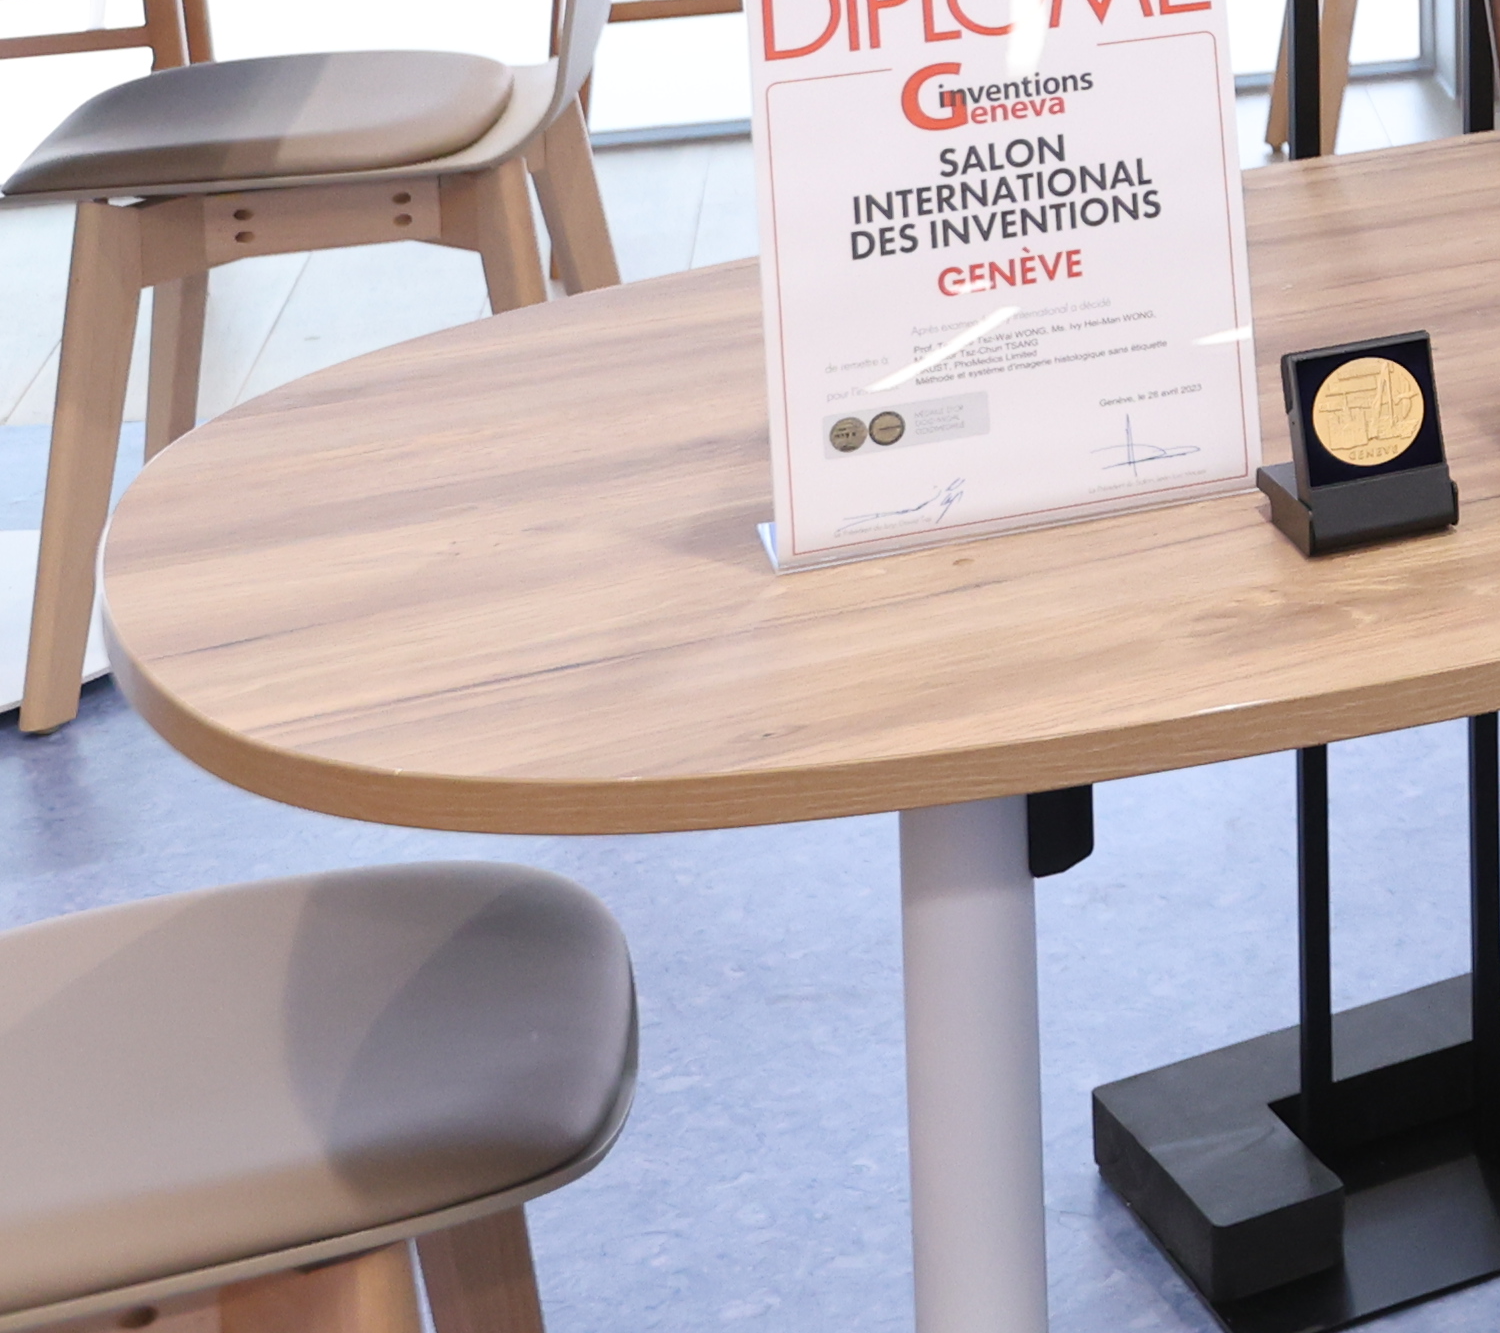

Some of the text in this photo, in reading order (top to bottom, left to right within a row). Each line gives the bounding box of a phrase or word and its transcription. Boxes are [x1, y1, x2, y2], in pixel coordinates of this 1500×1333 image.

[938, 70, 1094, 108] inventions
[939, 133, 1066, 178] SALON
[852, 158, 1152, 225] INTERNATIONAL
[851, 190, 1162, 260] DES INVENTIONS
[938, 247, 1083, 297] GENÈVE
